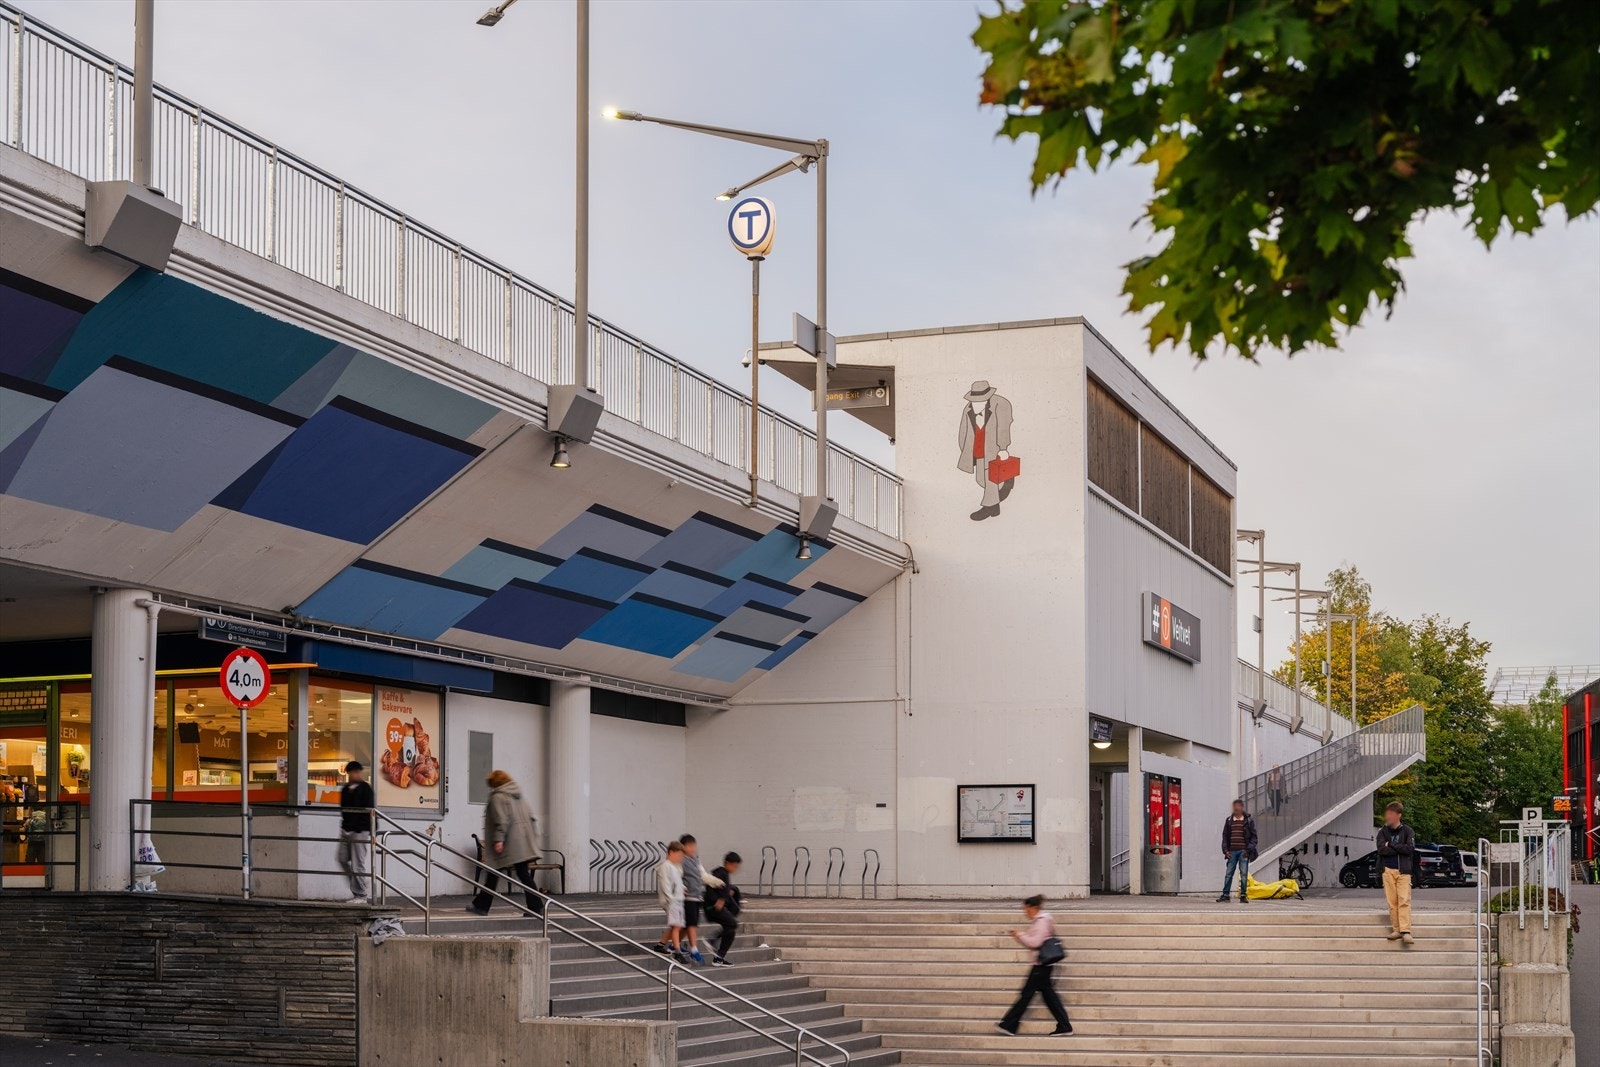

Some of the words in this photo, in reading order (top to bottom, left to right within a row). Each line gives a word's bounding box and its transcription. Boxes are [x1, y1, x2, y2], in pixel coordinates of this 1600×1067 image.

[738, 209, 762, 241] T
[845, 391, 860, 399] Exit
[228, 623, 247, 633] Direction
[248, 627, 256, 635] city
[256, 629, 269, 637] centre
[381, 690, 399, 703] Kaffe
[381, 701, 413, 714] bakervare
[213, 737, 231, 749] MAT
[1527, 810, 1537, 825] P
